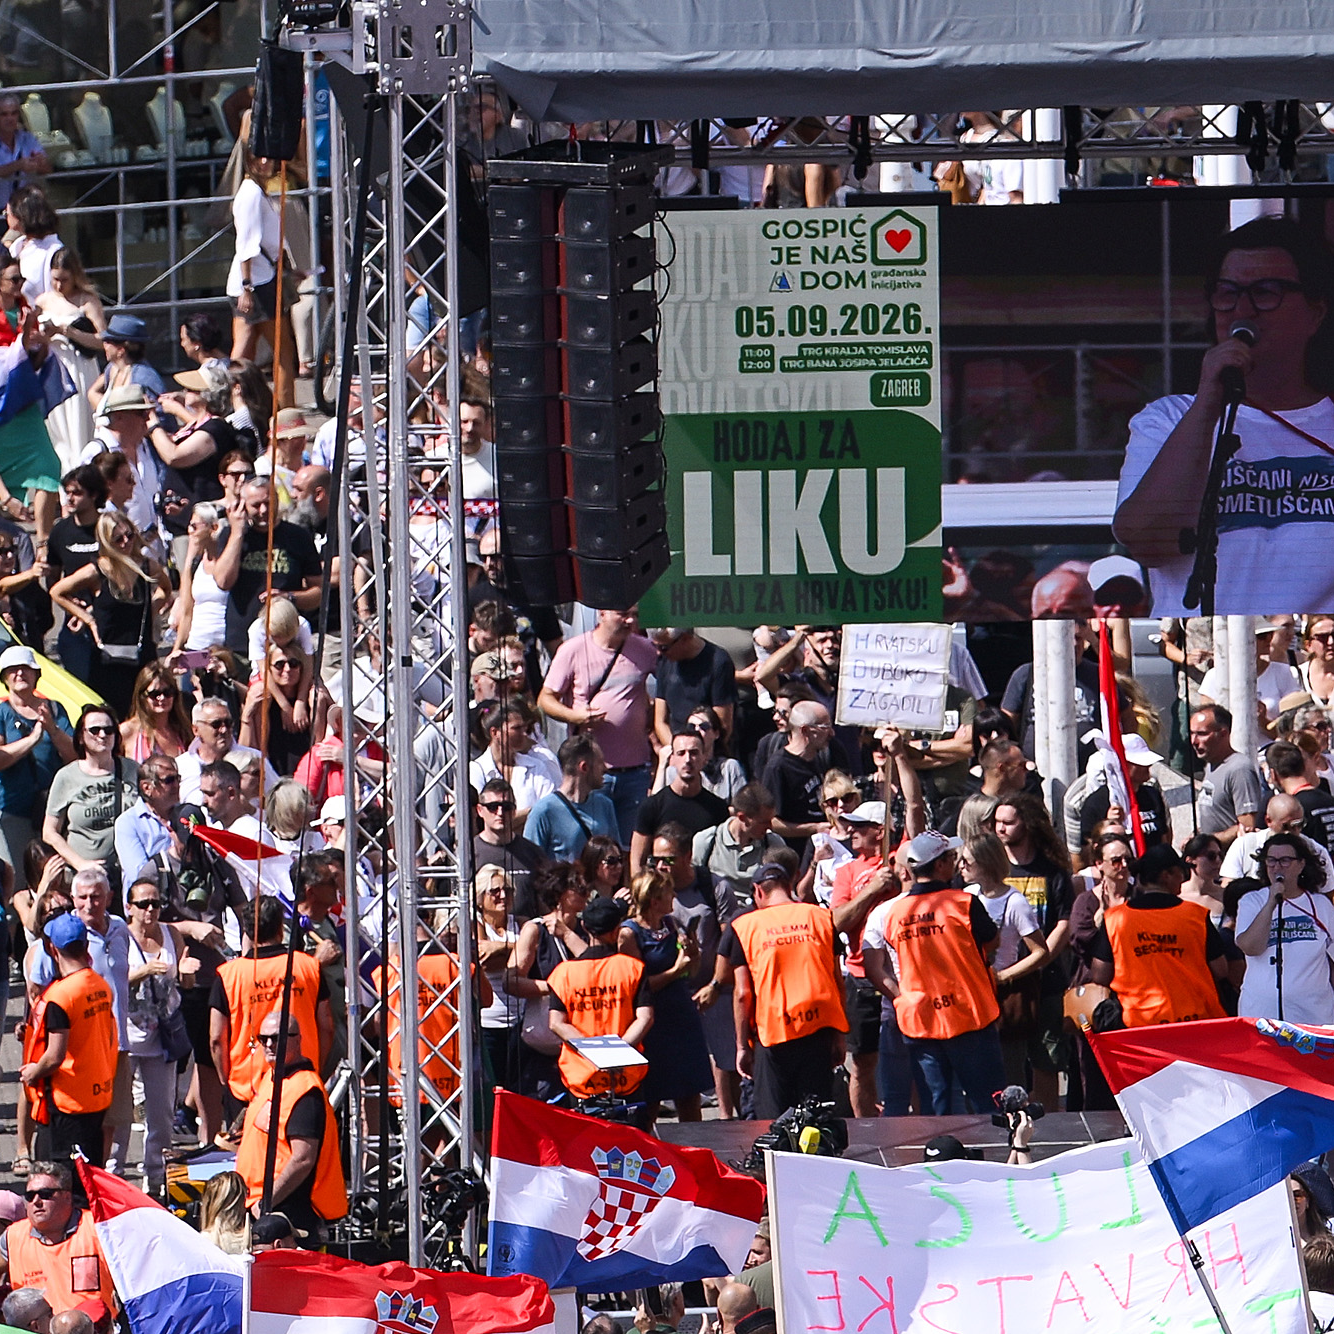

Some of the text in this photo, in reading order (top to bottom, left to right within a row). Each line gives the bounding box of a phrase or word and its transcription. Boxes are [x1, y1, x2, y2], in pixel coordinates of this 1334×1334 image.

[762, 214, 867, 239] GOSPIĆ
[770, 239, 867, 265] JE NAŠ
[800, 270, 867, 290] DOM
[871, 268, 926, 279] građanska
[871, 280, 922, 291] inicijativa
[735, 303, 932, 337] 05.09.2026.
[744, 346, 929, 358] 11:00 TRG KRALJA TOMISLAVA
[743, 360, 771, 369] 12:00
[783, 360, 805, 369] TRG
[807, 359, 836, 368] BANA
[839, 358, 877, 367] JOSIPA
[881, 378, 921, 397] ZAGREB
[714, 418, 860, 462] HODAJ ZA
[1221, 461, 1291, 489] IŠČANI
[683, 467, 906, 576] LIKU
[670, 577, 928, 616] HODAJ ZA HRVATSKU!
[766, 923, 811, 937] KLEMM
[575, 983, 618, 998] KLEMM
